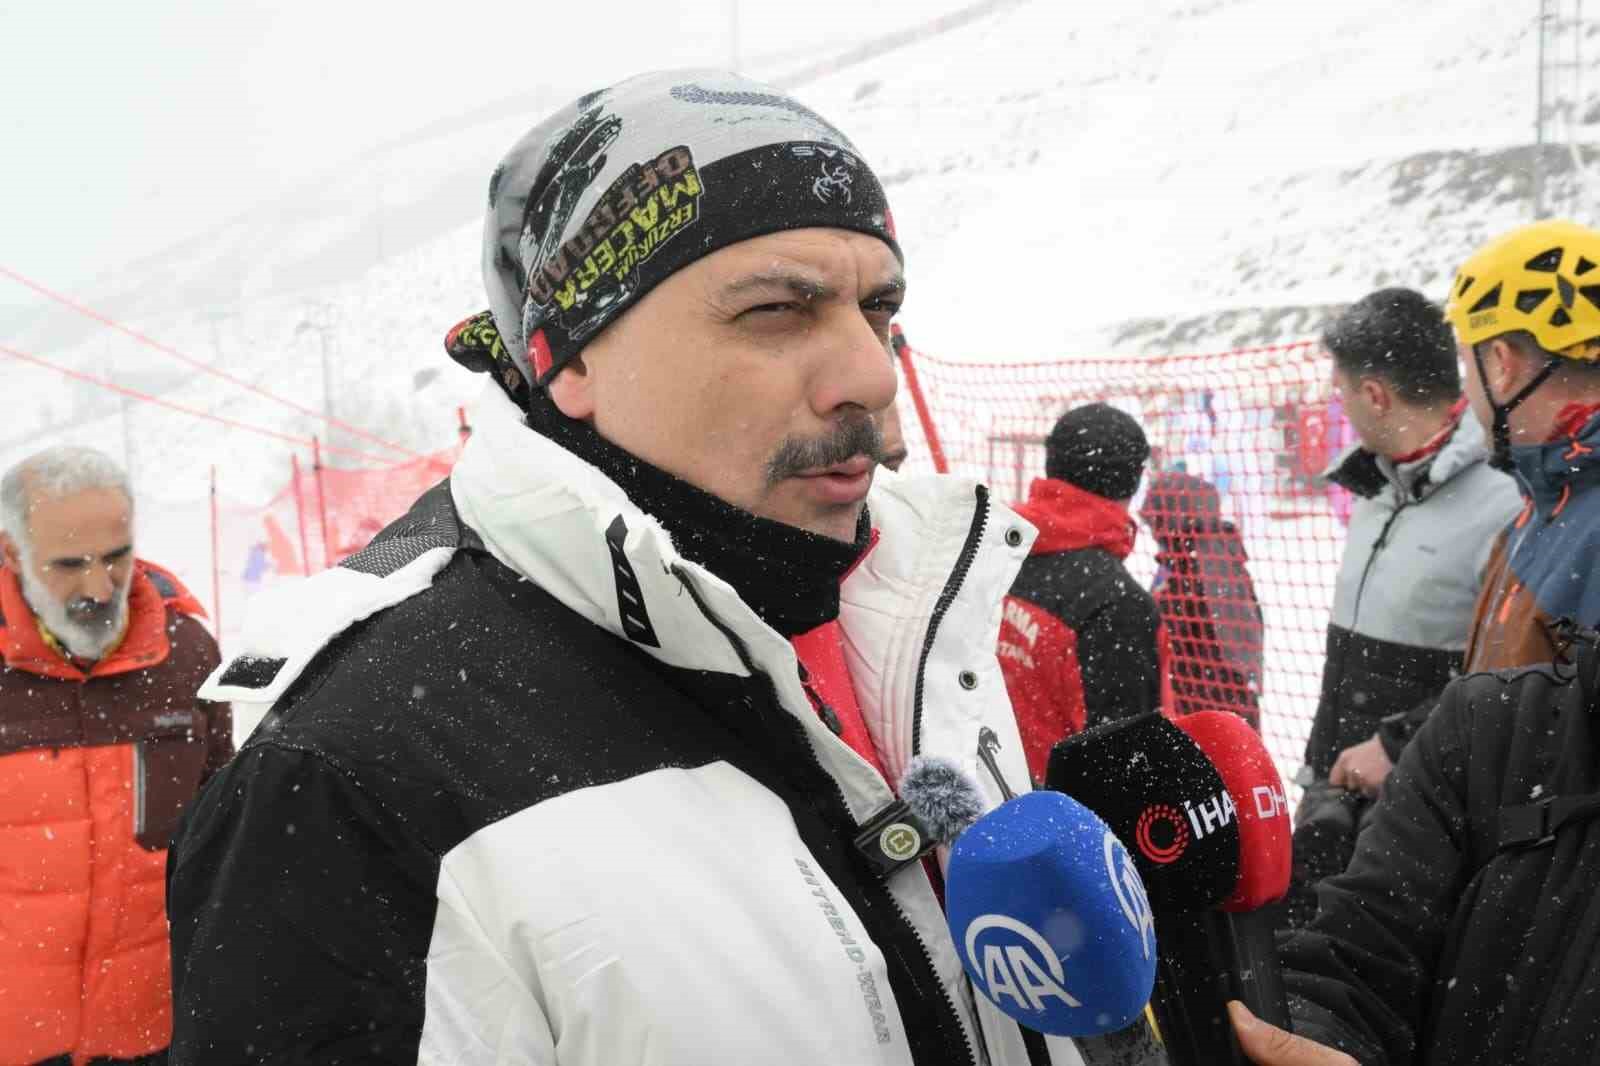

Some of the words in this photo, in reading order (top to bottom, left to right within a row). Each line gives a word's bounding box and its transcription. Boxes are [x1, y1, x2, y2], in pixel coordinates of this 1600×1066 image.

[554, 169, 701, 310] MACERA
[615, 203, 693, 281] ERZURUM
[984, 944, 1084, 1010] AA
